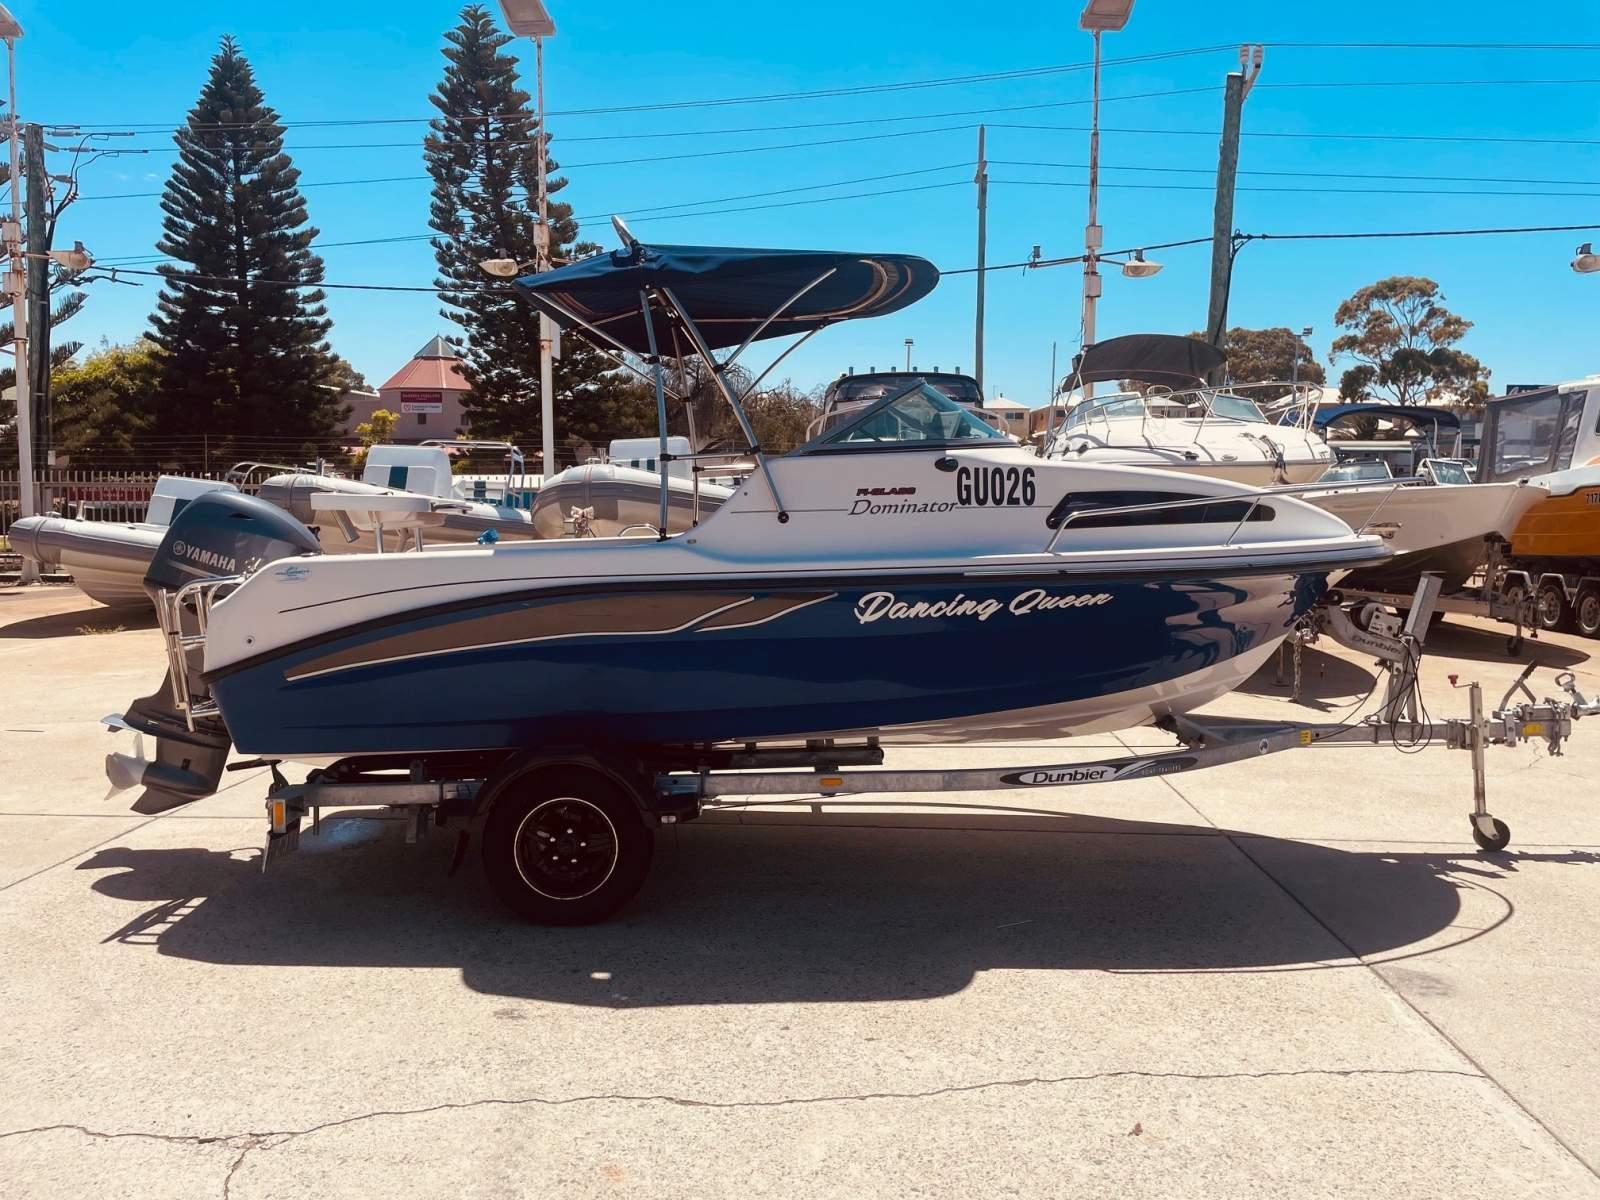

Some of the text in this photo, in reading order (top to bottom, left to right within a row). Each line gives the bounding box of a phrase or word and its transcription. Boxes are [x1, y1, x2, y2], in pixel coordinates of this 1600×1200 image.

[848, 498, 958, 516] Dominator
[185, 544, 237, 572] YAMAHA
[853, 588, 1115, 625] Dancing Queen
[1032, 768, 1107, 784] Dunbier
